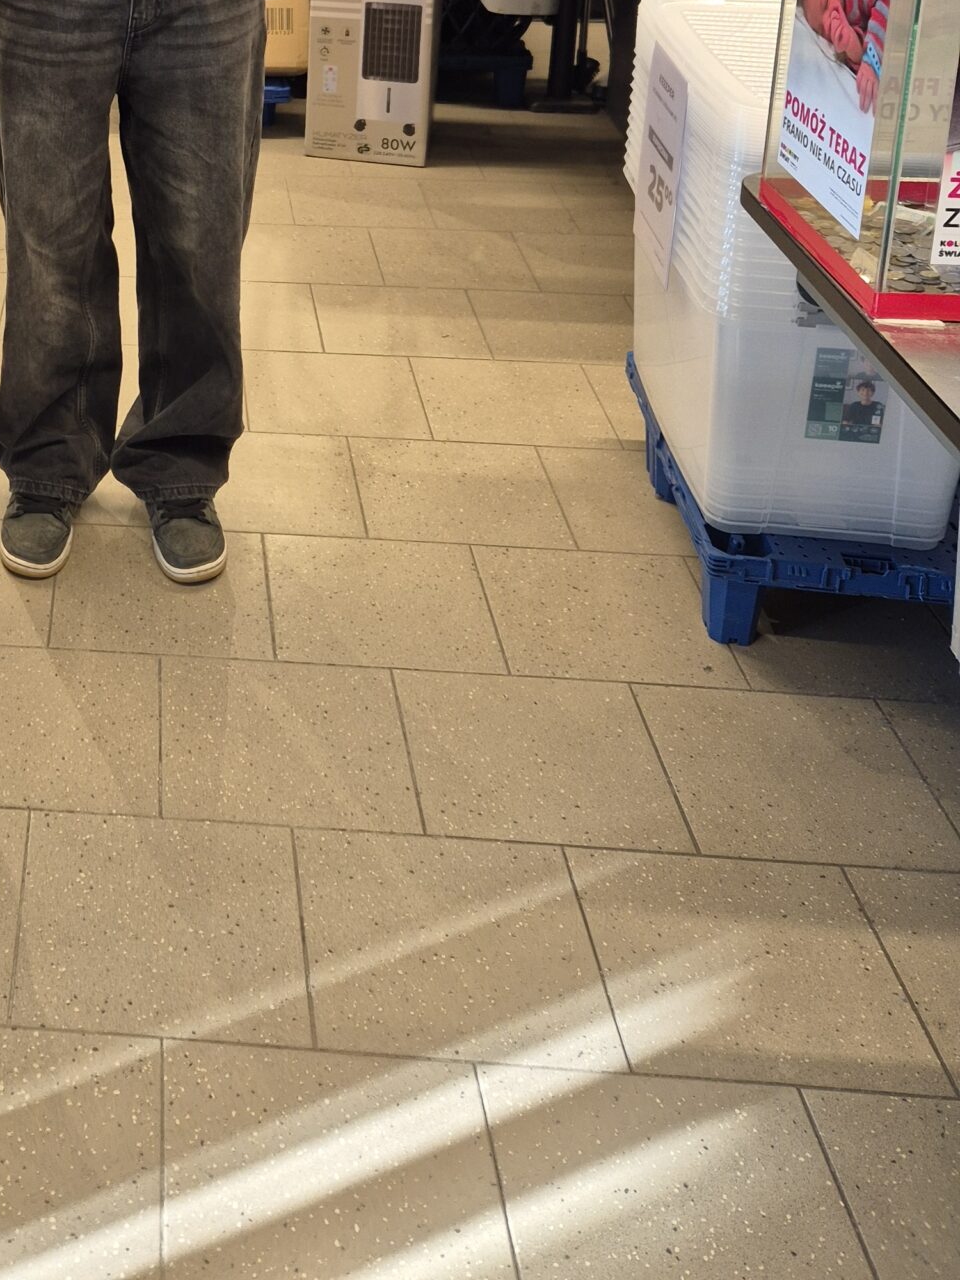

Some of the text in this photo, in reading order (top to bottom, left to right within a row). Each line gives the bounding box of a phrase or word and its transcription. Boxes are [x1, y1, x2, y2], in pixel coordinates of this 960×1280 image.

[381, 137, 416, 151] 80W
[782, 116, 863, 197] FRANIO NIE MA CZASU
[784, 89, 868, 177] POMÓŻ TERAZ
